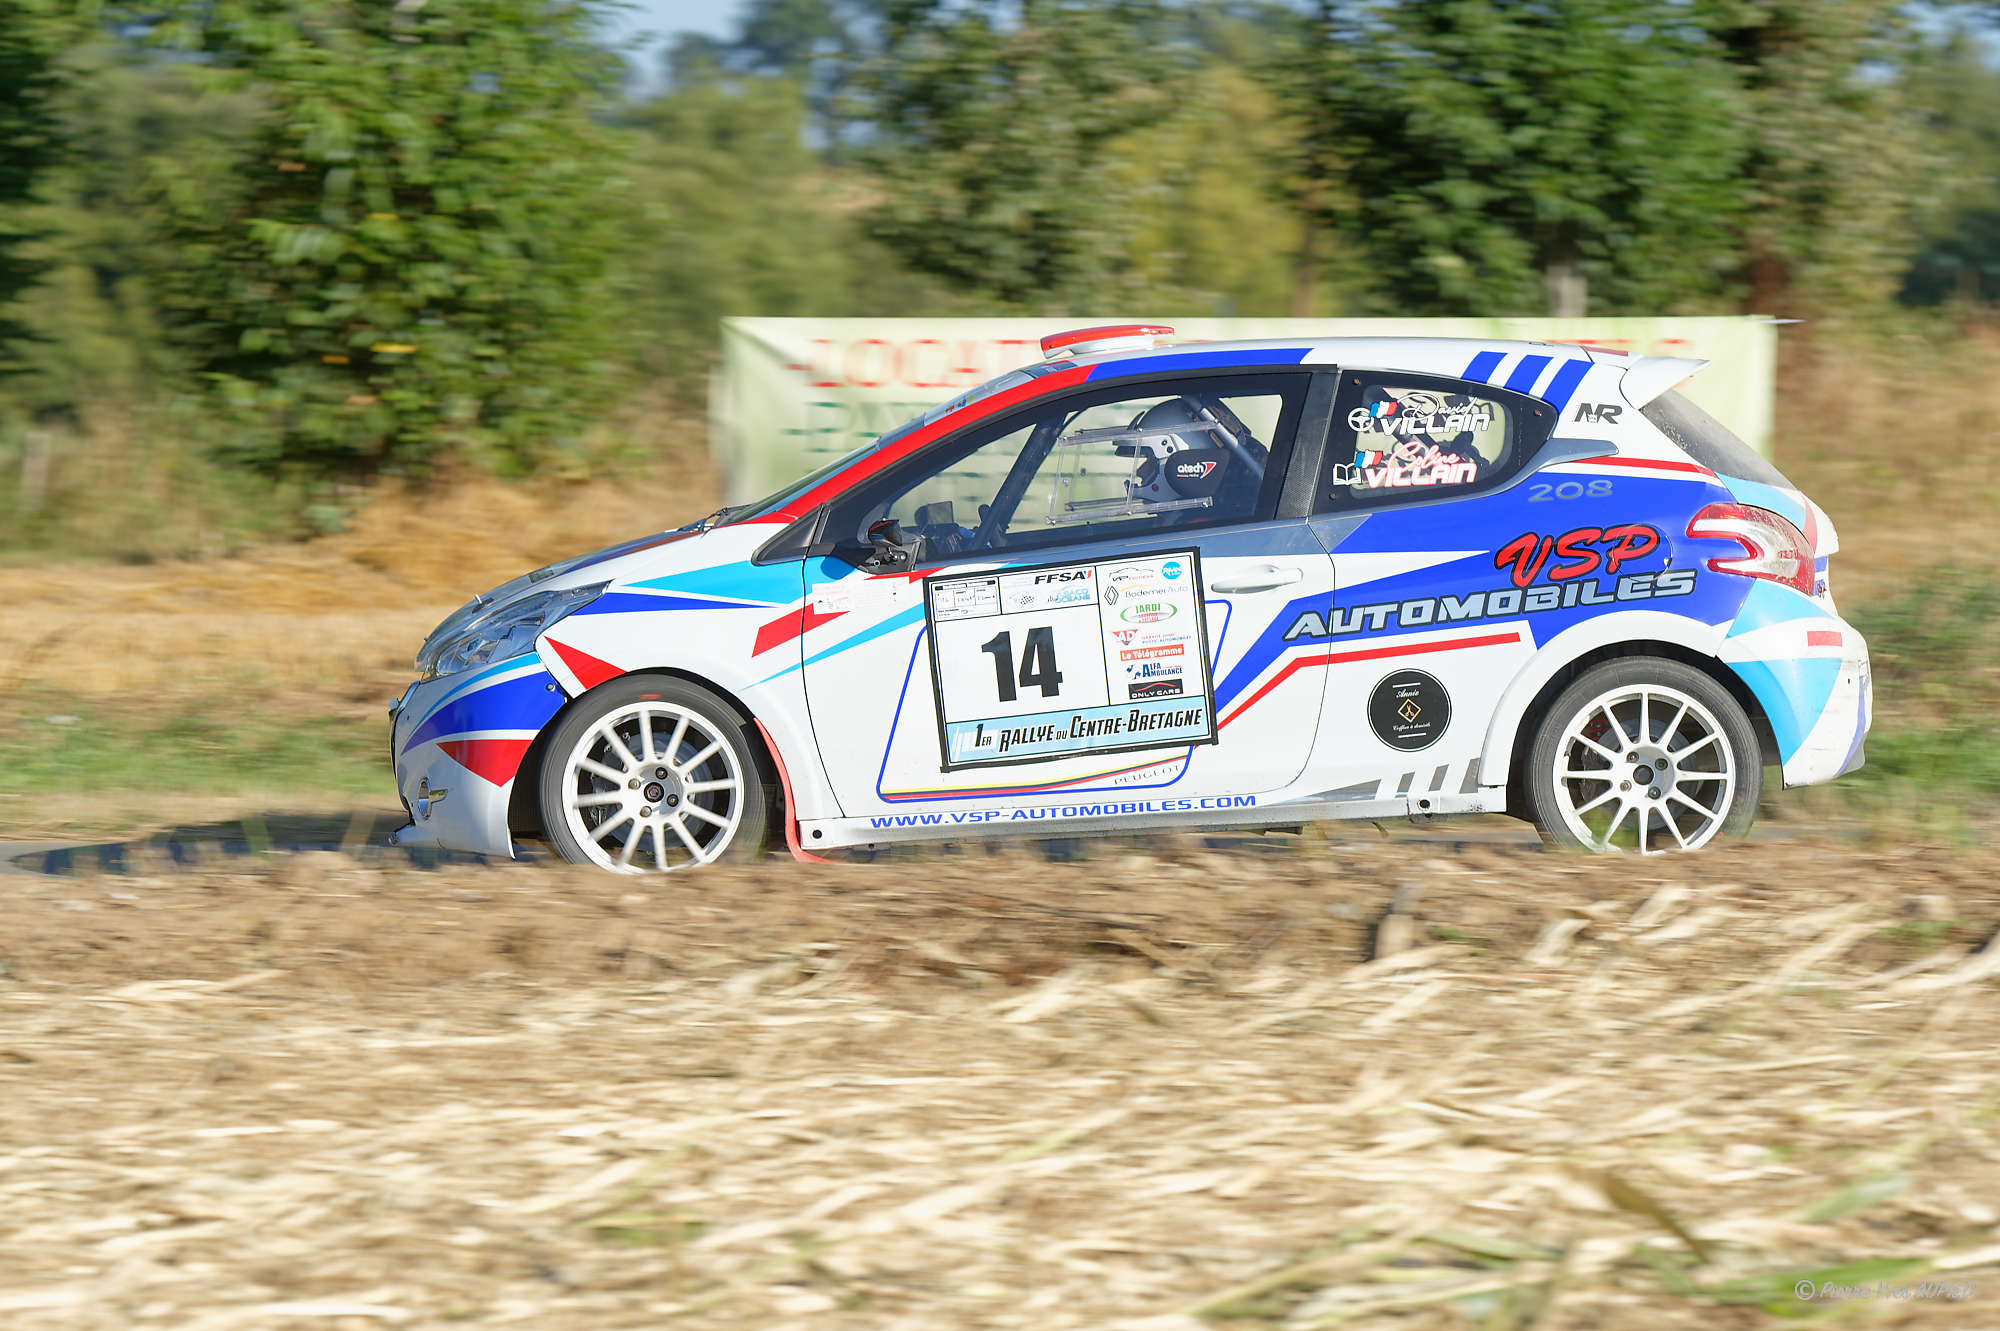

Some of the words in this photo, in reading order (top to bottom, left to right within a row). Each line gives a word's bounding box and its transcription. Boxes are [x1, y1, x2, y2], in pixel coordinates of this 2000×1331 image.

[1398, 392, 1478, 419] David
[1380, 413, 1491, 436] VILLAIN
[1365, 463, 1477, 489] VILLAIN
[1528, 480, 1614, 503] 208
[1494, 524, 1661, 587] VSP
[1034, 570, 1086, 585] FFSA
[1282, 569, 1698, 641] AUTOMOBILES
[981, 626, 1063, 702] 14
[998, 724, 1055, 752] RALLYE
[1114, 764, 1180, 785] PEUGEOT
[870, 795, 1256, 829] WWW.VSP-AUTOMOBILES.COM
